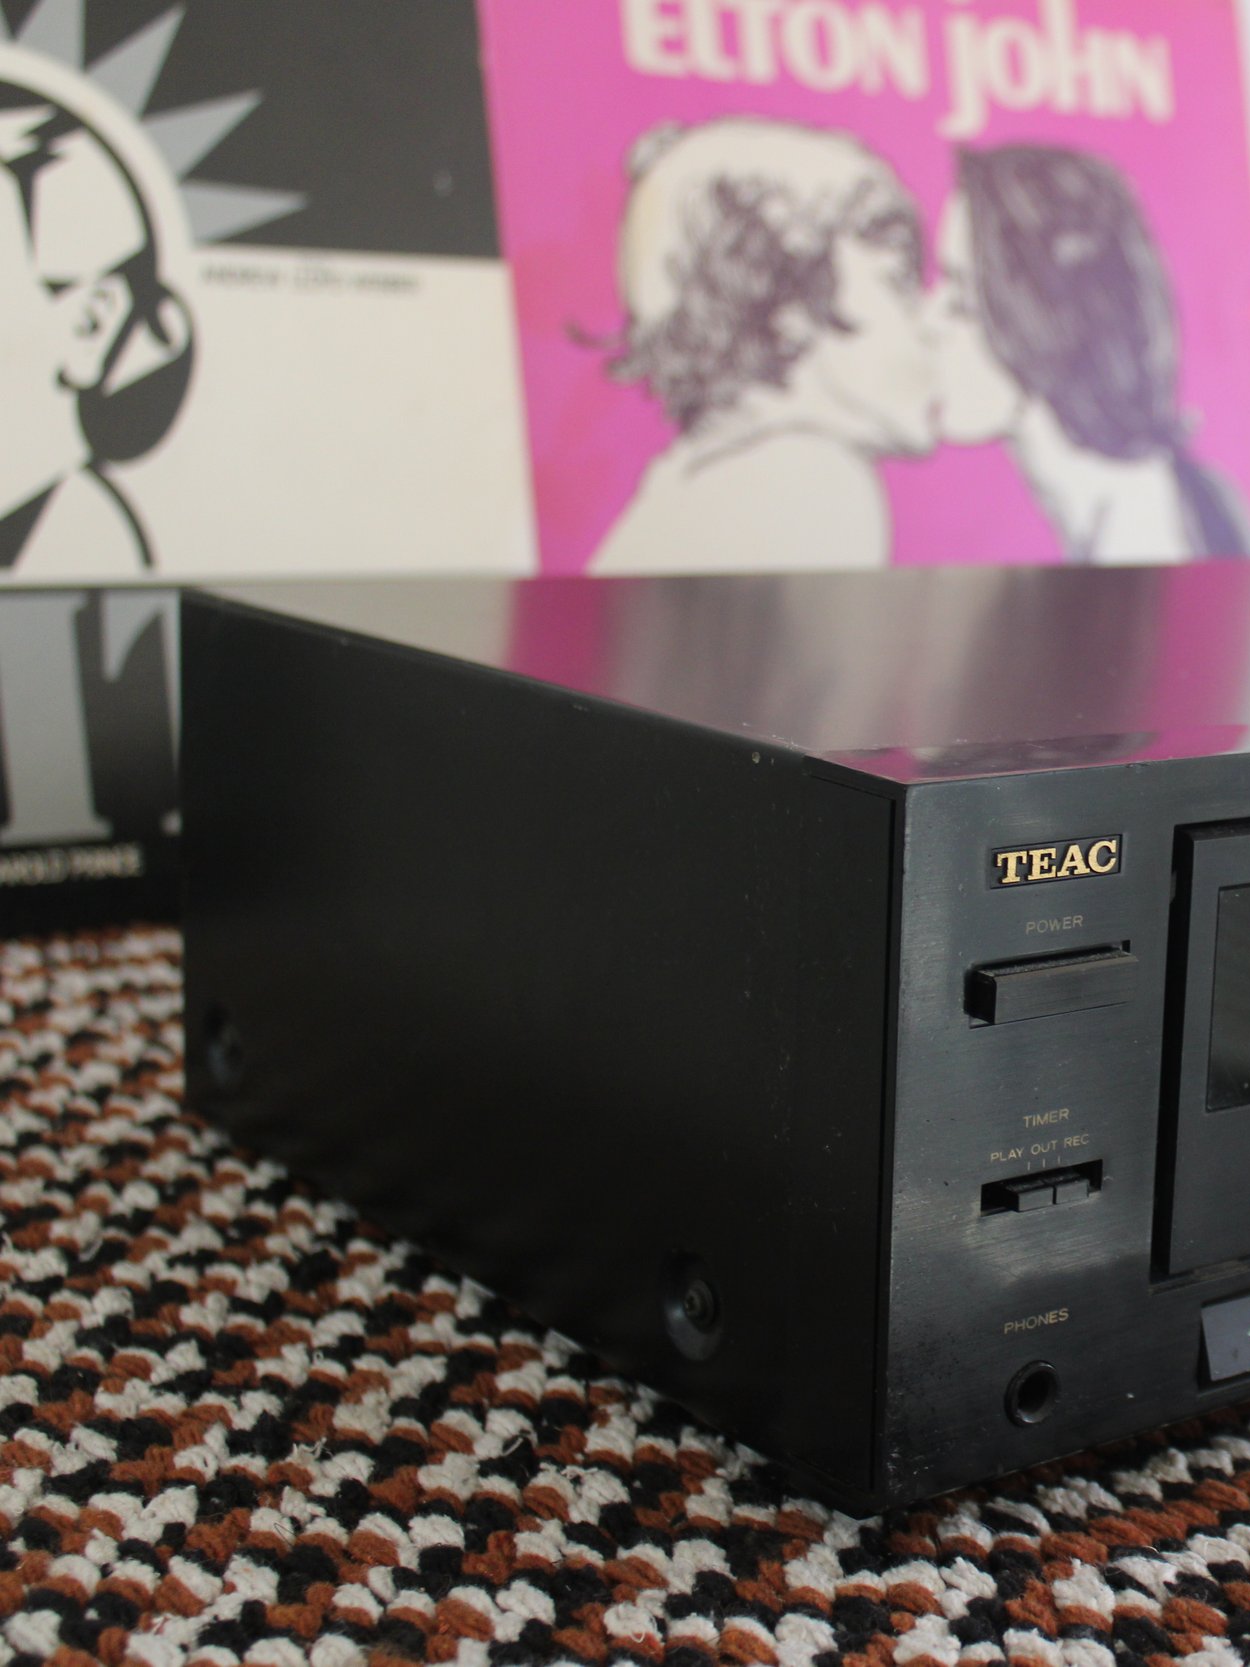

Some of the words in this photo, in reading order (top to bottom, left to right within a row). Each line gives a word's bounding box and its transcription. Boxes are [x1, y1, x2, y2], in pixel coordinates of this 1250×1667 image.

[620, 0, 931, 101] ELTON
[996, 839, 1118, 884] TEAC
[1025, 915, 1084, 935] POWER
[1023, 1108, 1070, 1128] TIMER
[990, 1146, 1024, 1162] PLAY
[1030, 1140, 1058, 1155] OUT
[1064, 1133, 1090, 1149] REC
[1004, 1307, 1070, 1335] PHONES
